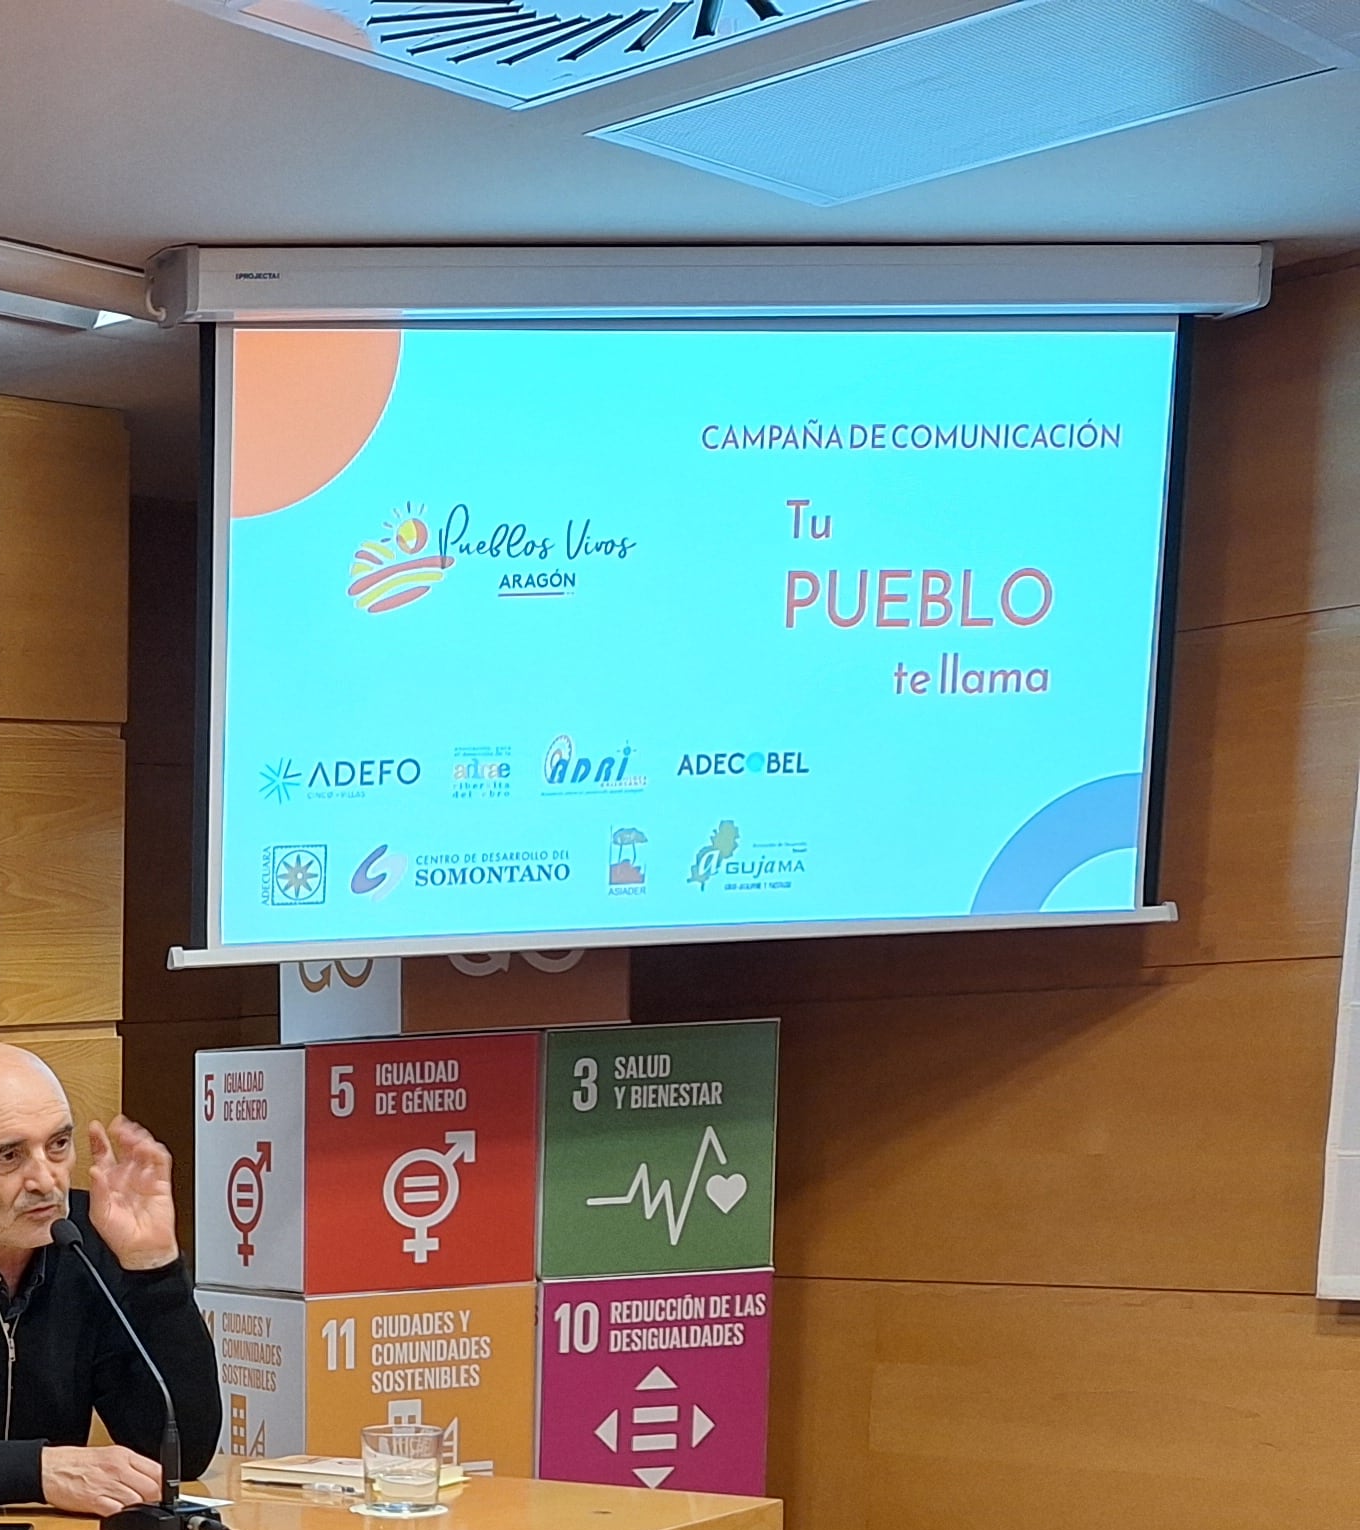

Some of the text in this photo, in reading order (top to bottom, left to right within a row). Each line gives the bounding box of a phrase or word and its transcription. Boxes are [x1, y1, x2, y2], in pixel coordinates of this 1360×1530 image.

[701, 418, 1121, 450] CAMPAÑA DE COMUNICACIÓN
[786, 499, 832, 539] Tu
[438, 503, 637, 569] Pueblos Vivos
[498, 569, 576, 589] ARAGÓN
[785, 567, 1053, 629] PUEBLO
[894, 652, 1049, 695] te llama
[308, 758, 421, 788] ADEFO
[416, 853, 460, 865] CENTRO
[464, 853, 476, 863] DE
[481, 850, 548, 862] DESARROLLO
[261, 846, 272, 906] ADECUARA
[415, 863, 571, 887] SOMONTANO
[223, 1070, 265, 1094] IGUALDAD
[375, 1060, 459, 1086] IGUALDAD
[614, 1054, 671, 1080] SALUD
[204, 1073, 215, 1122] 5
[330, 1065, 355, 1118] 5
[572, 1057, 599, 1112] 3
[613, 1081, 723, 1109] Y BIENESTAR
[223, 1096, 268, 1121] DE GÉNERO
[375, 1087, 467, 1115] DE GÉNERO
[371, 1309, 471, 1339] CIUDADES Y
[609, 1293, 767, 1325] REDUCCIÓN DE LAS
[222, 1311, 272, 1338] CIUDADES Y
[553, 1301, 600, 1354] 10
[609, 1323, 745, 1353] DESIGUALDADES
[222, 1337, 282, 1367] COMUNIDADES
[321, 1317, 355, 1370] 11
[371, 1336, 491, 1366] COMUNIDADES
[222, 1363, 277, 1393] SOSTENIBLES
[371, 1364, 481, 1394] SOSTENIBLES
